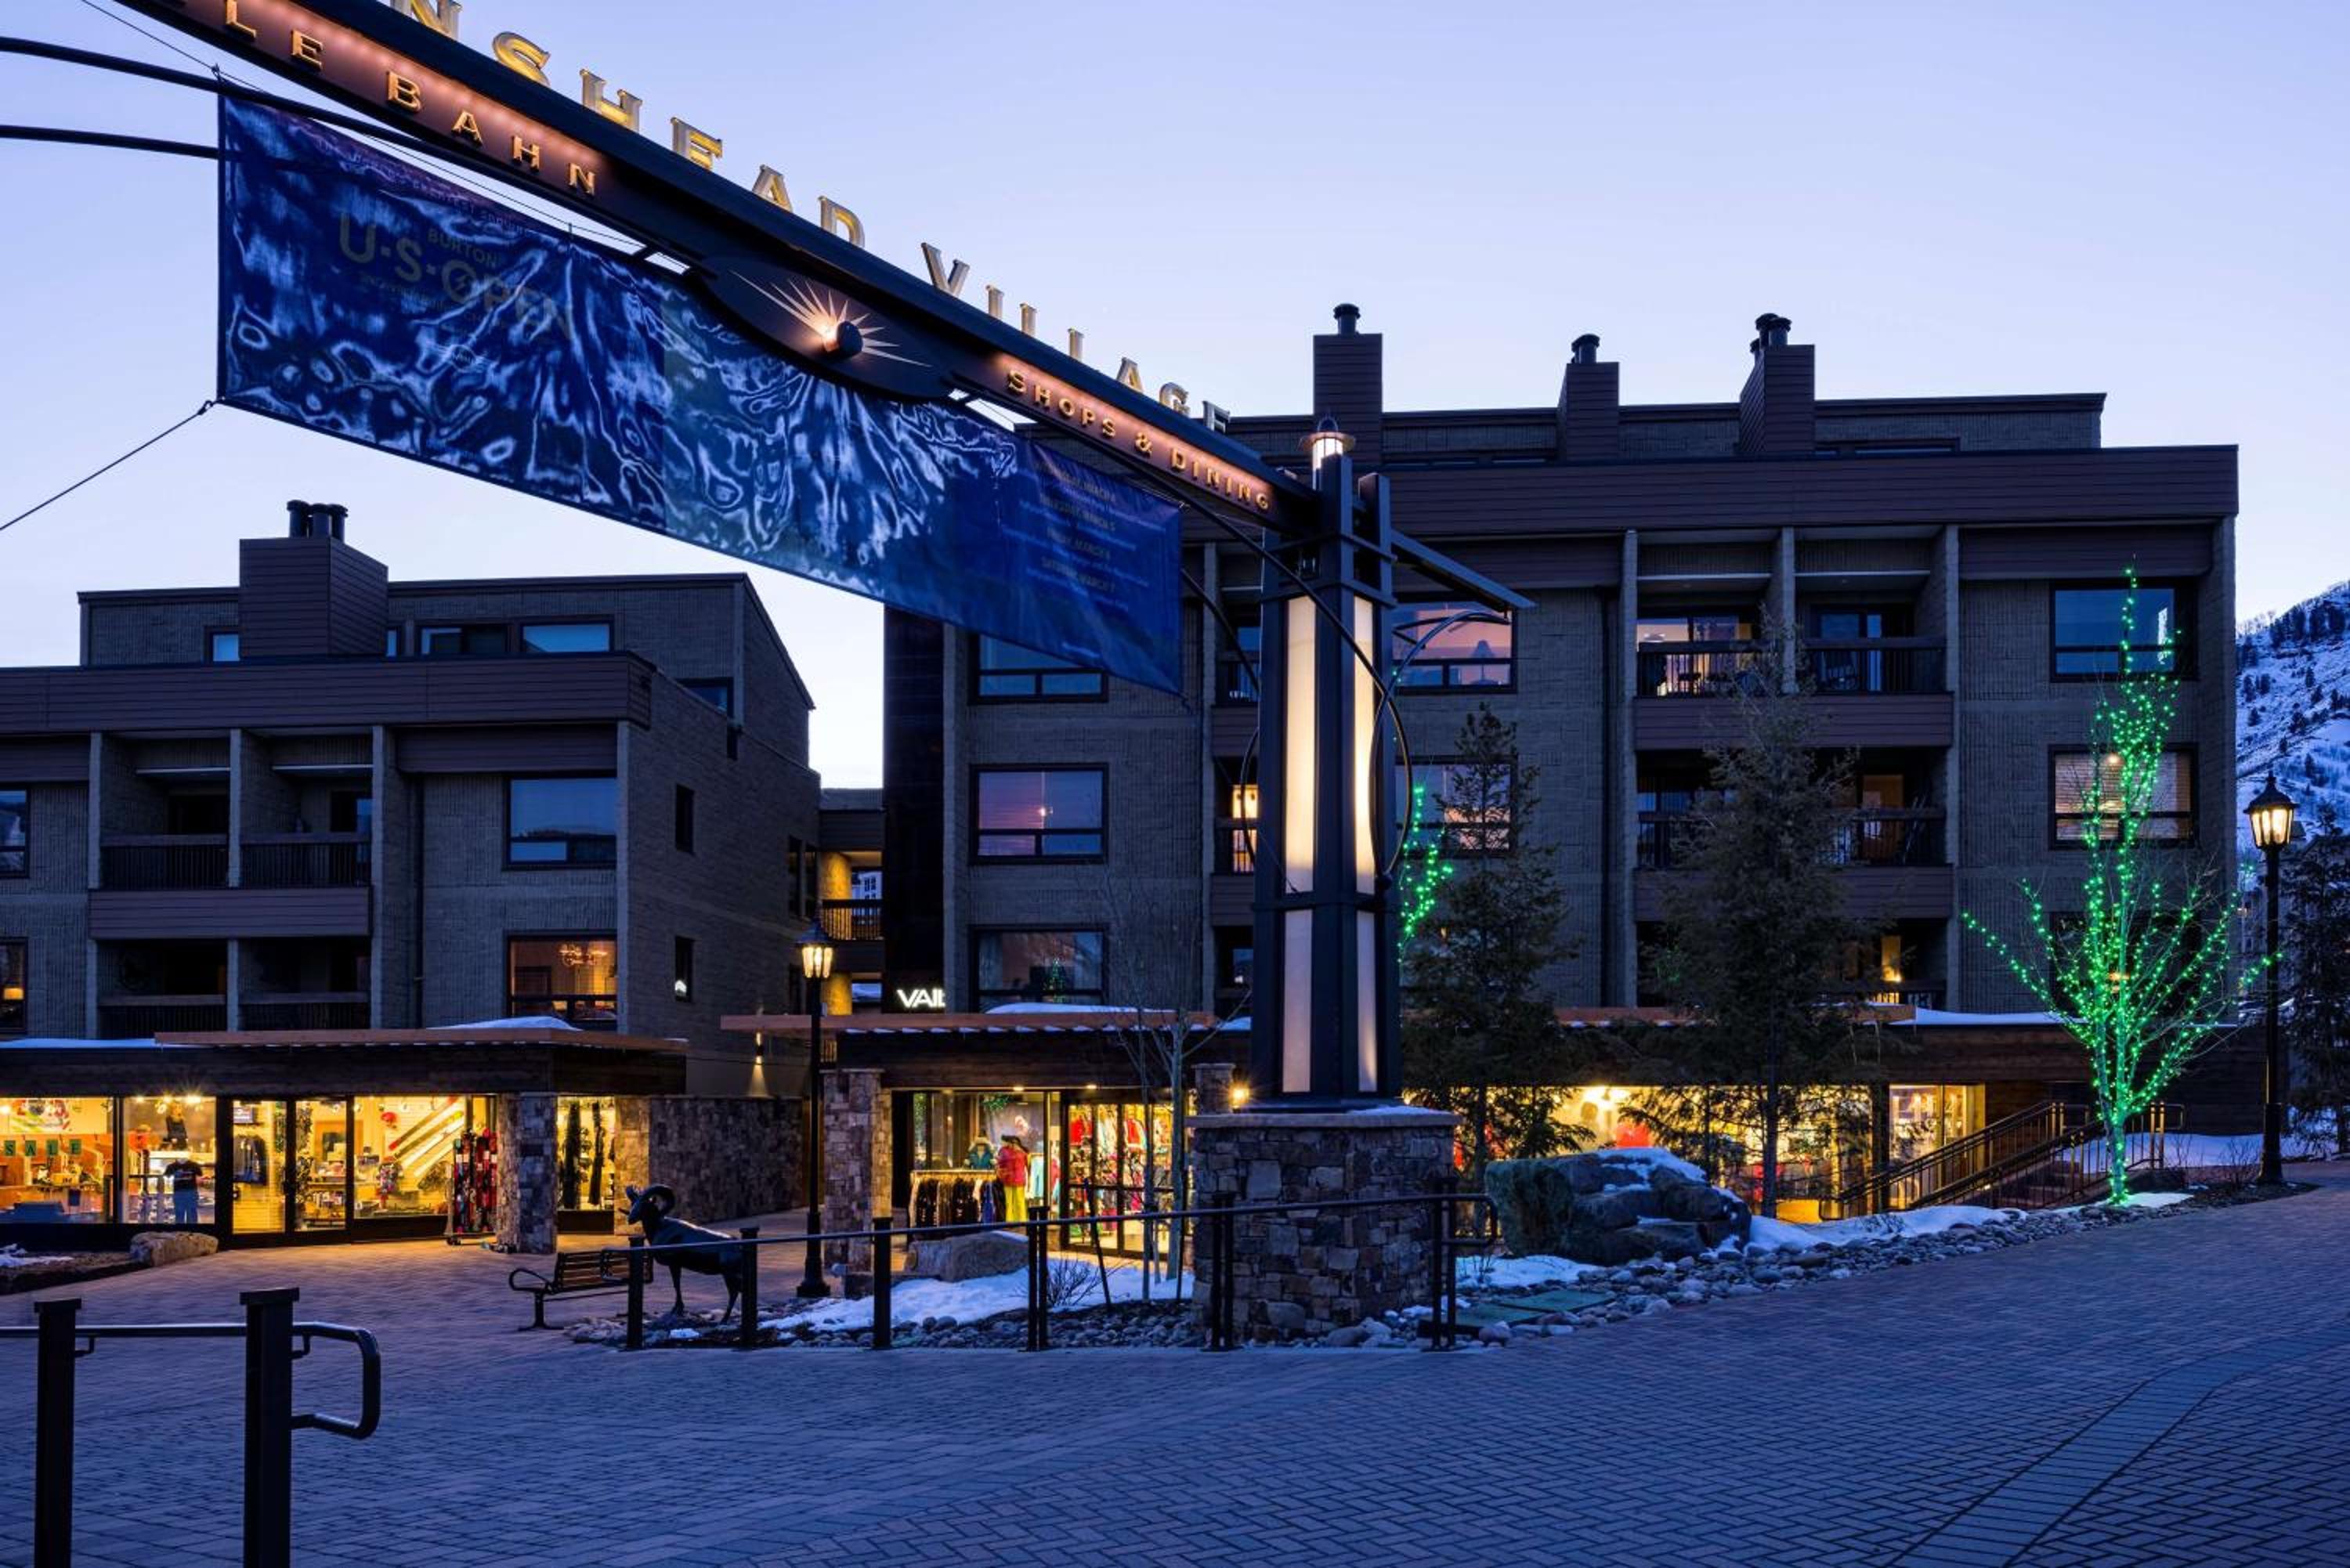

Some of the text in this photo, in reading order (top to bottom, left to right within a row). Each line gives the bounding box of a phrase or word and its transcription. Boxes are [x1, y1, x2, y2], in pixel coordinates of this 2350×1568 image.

[387, 70, 595, 197] BAHN
[427, 227, 501, 269] BURTON
[1007, 368, 1116, 439] SHOPS
[1135, 431, 1153, 457] &
[1170, 447, 1270, 511] DINING
[5, 1141, 80, 1156] SALE
